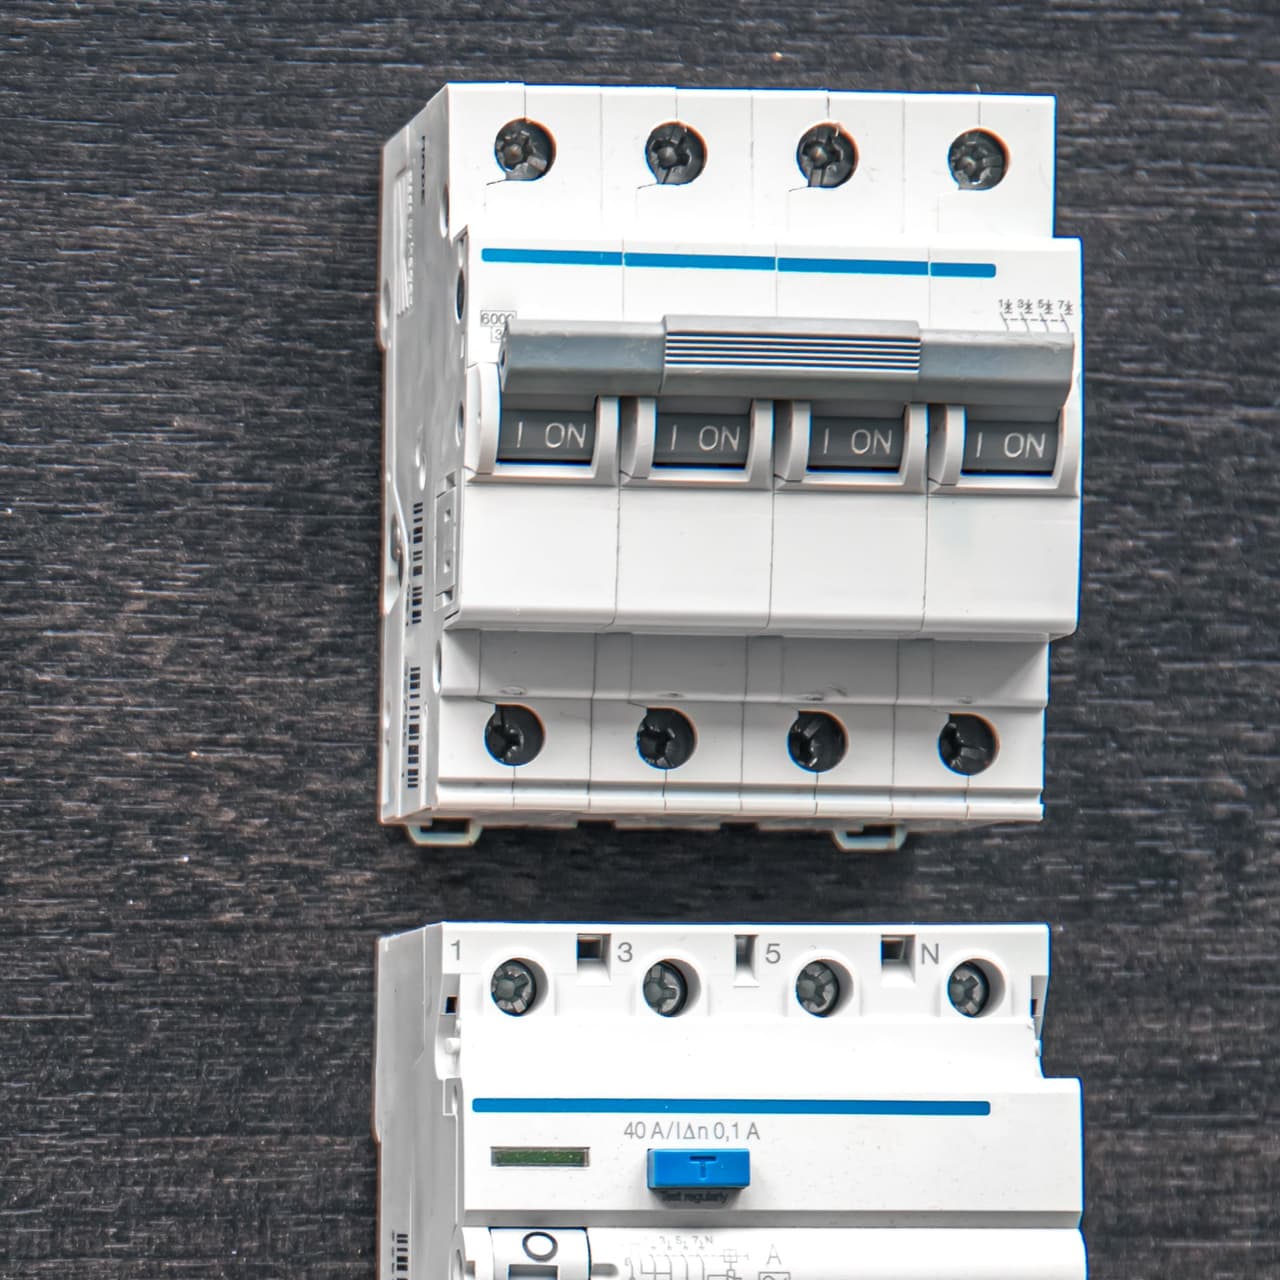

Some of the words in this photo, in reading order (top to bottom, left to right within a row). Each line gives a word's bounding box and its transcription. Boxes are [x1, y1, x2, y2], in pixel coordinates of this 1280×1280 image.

[546, 424, 585, 448] ON
[699, 428, 739, 450] ON
[852, 432, 891, 454] ON
[1005, 434, 1044, 457] ON
[451, 940, 460, 960] 1
[618, 942, 632, 962] 3
[766, 943, 780, 964] 5
[922, 944, 939, 964] N
[624, 1121, 646, 1140] 40
[714, 1121, 739, 1142] 0,1
[747, 1122, 760, 1140] A
[689, 1155, 717, 1181] T
[766, 1244, 782, 1265] A
